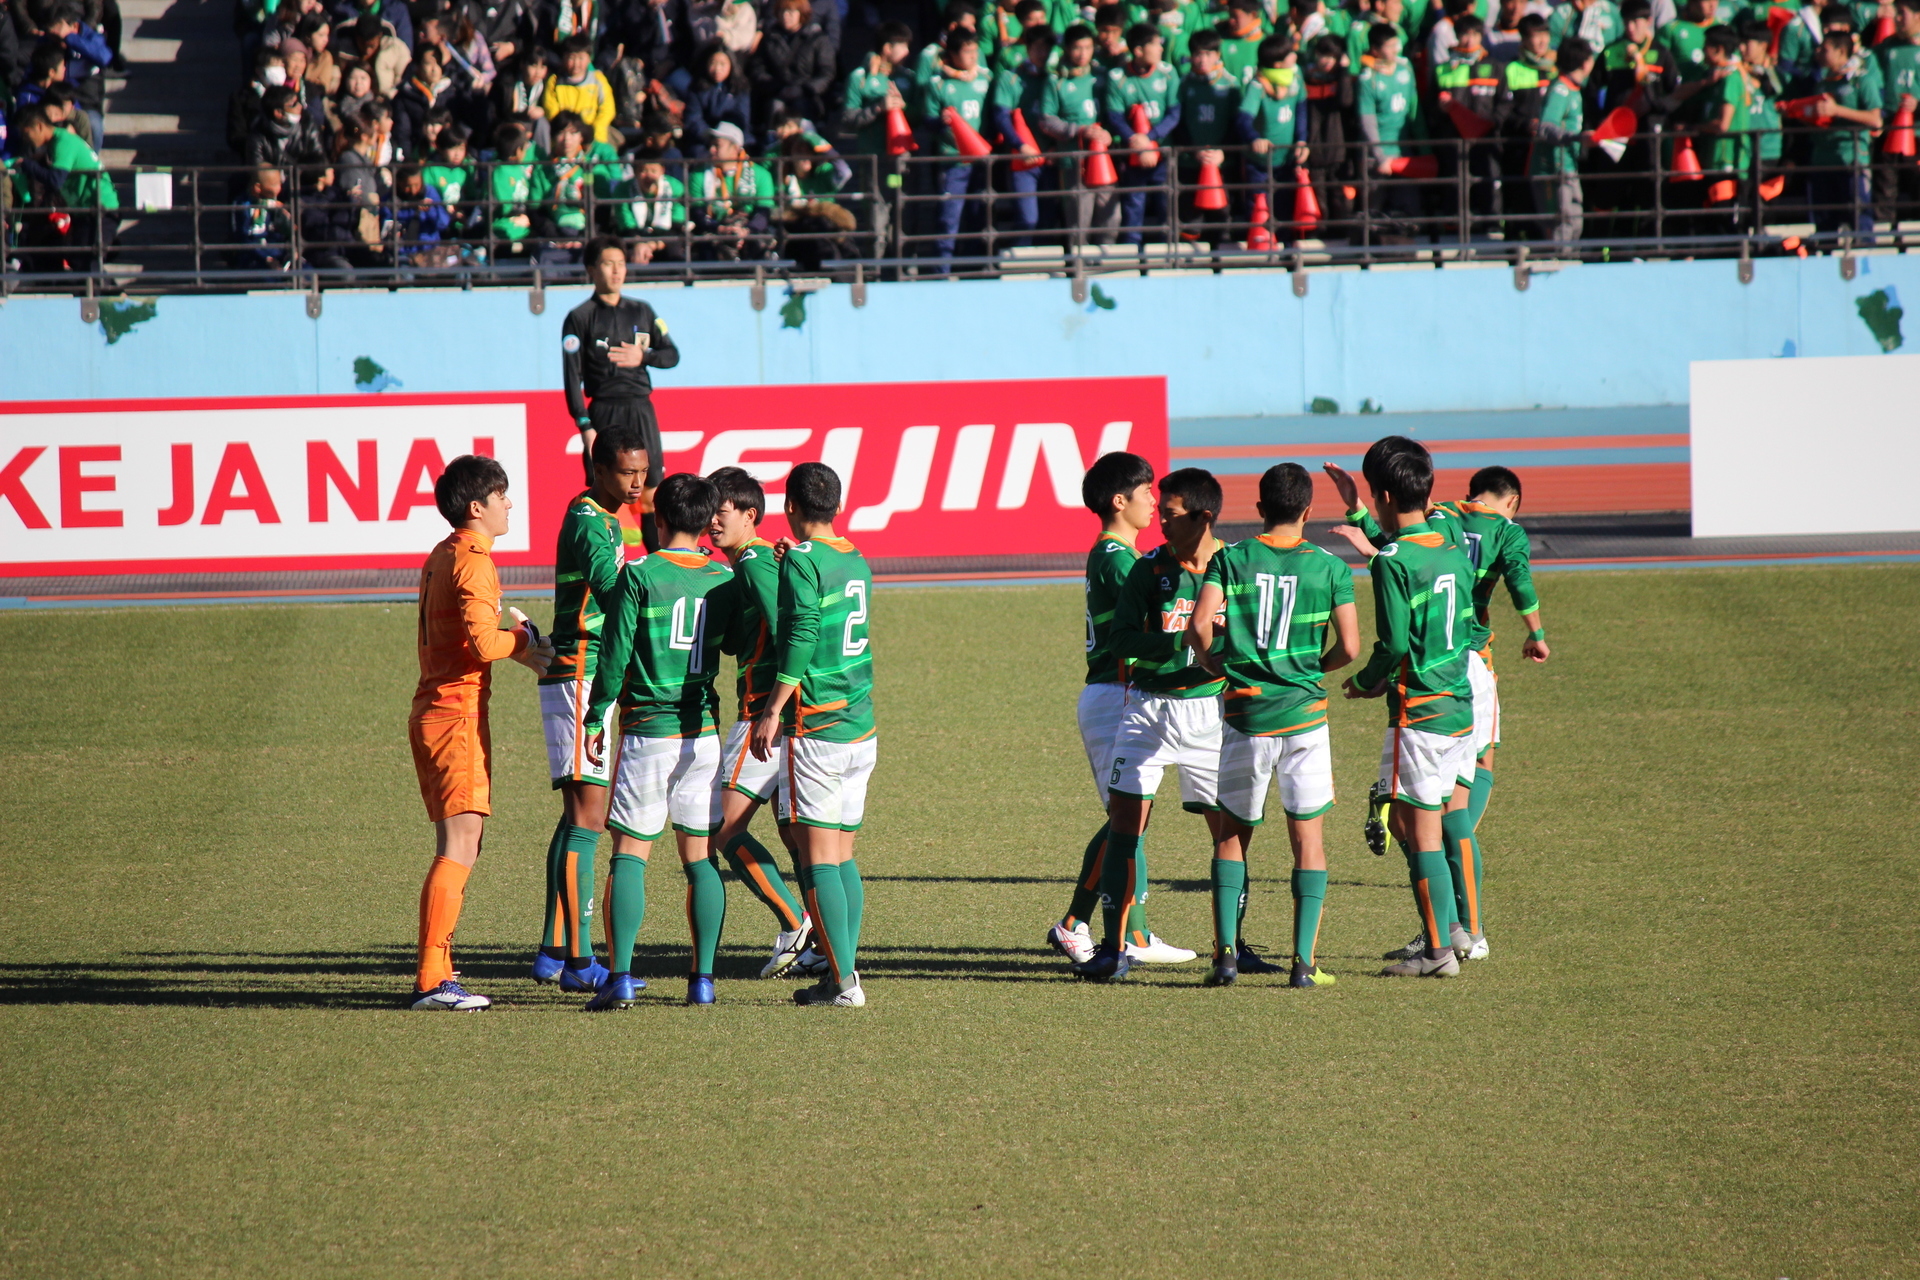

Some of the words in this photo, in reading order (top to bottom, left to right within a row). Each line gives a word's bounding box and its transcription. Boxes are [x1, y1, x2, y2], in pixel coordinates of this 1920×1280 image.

[157, 441, 281, 526] JA
[306, 436, 496, 523] NA
[669, 596, 708, 675] 4
[841, 579, 869, 657] 2
[1255, 572, 1299, 650] 11
[1433, 573, 1457, 650] 7
[1109, 757, 1126, 786] 6
